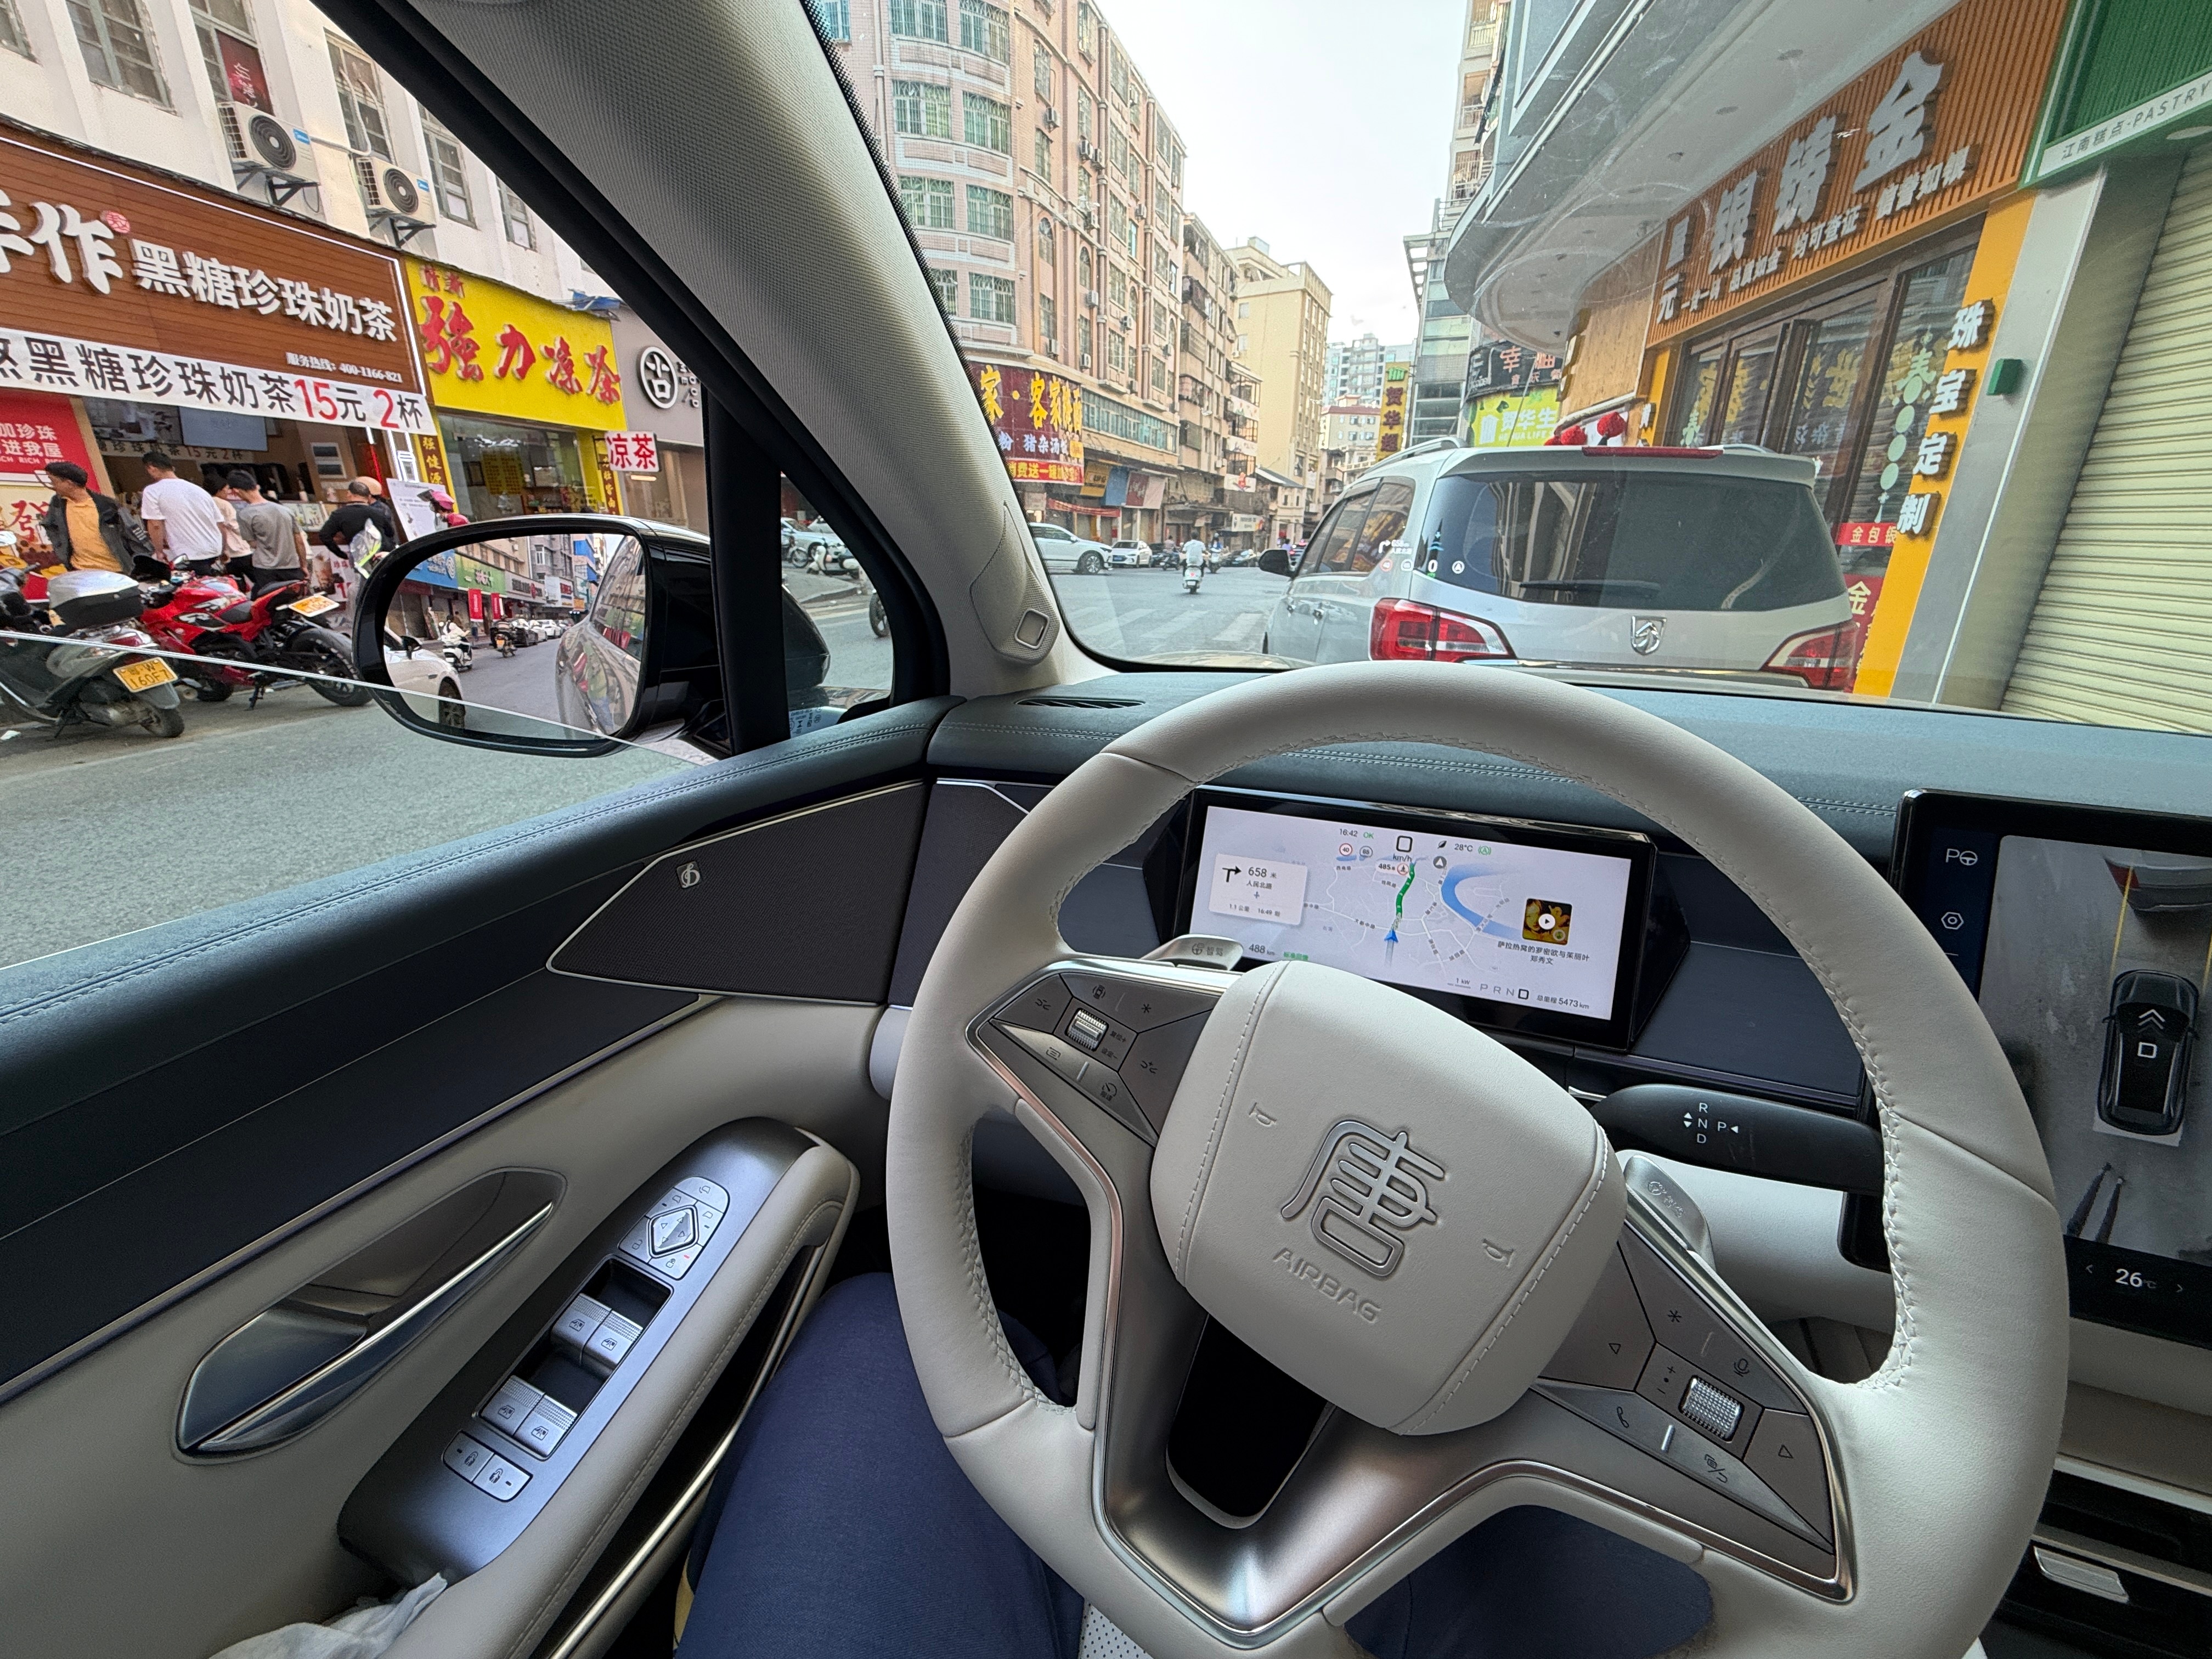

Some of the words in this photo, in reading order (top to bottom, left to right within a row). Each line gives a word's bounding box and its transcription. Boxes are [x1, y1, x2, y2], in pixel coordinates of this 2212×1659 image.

[1792, 205, 1862, 259] 均可查证
[132, 238, 398, 342] 黑糖珍珠奶茶
[338, 363, 403, 383] 400-1166-821
[1897, 301, 1985, 534] 珠宝定制
[607, 433, 656, 469] 凉茶
[1339, 828, 1358, 838] 16:42
[1392, 853, 1412, 862] km/h
[1248, 866, 1267, 878] 658
[1249, 944, 1265, 954] 488
[1530, 955, 1554, 966] 郑秀文
[1559, 997, 1578, 1007] 5473
[1699, 1102, 1708, 1114] R
[1697, 1118, 1708, 1129] N
[1717, 1121, 1727, 1132] P
[1696, 1133, 1707, 1144] D
[1273, 1247, 1382, 1324] AIRBAG
